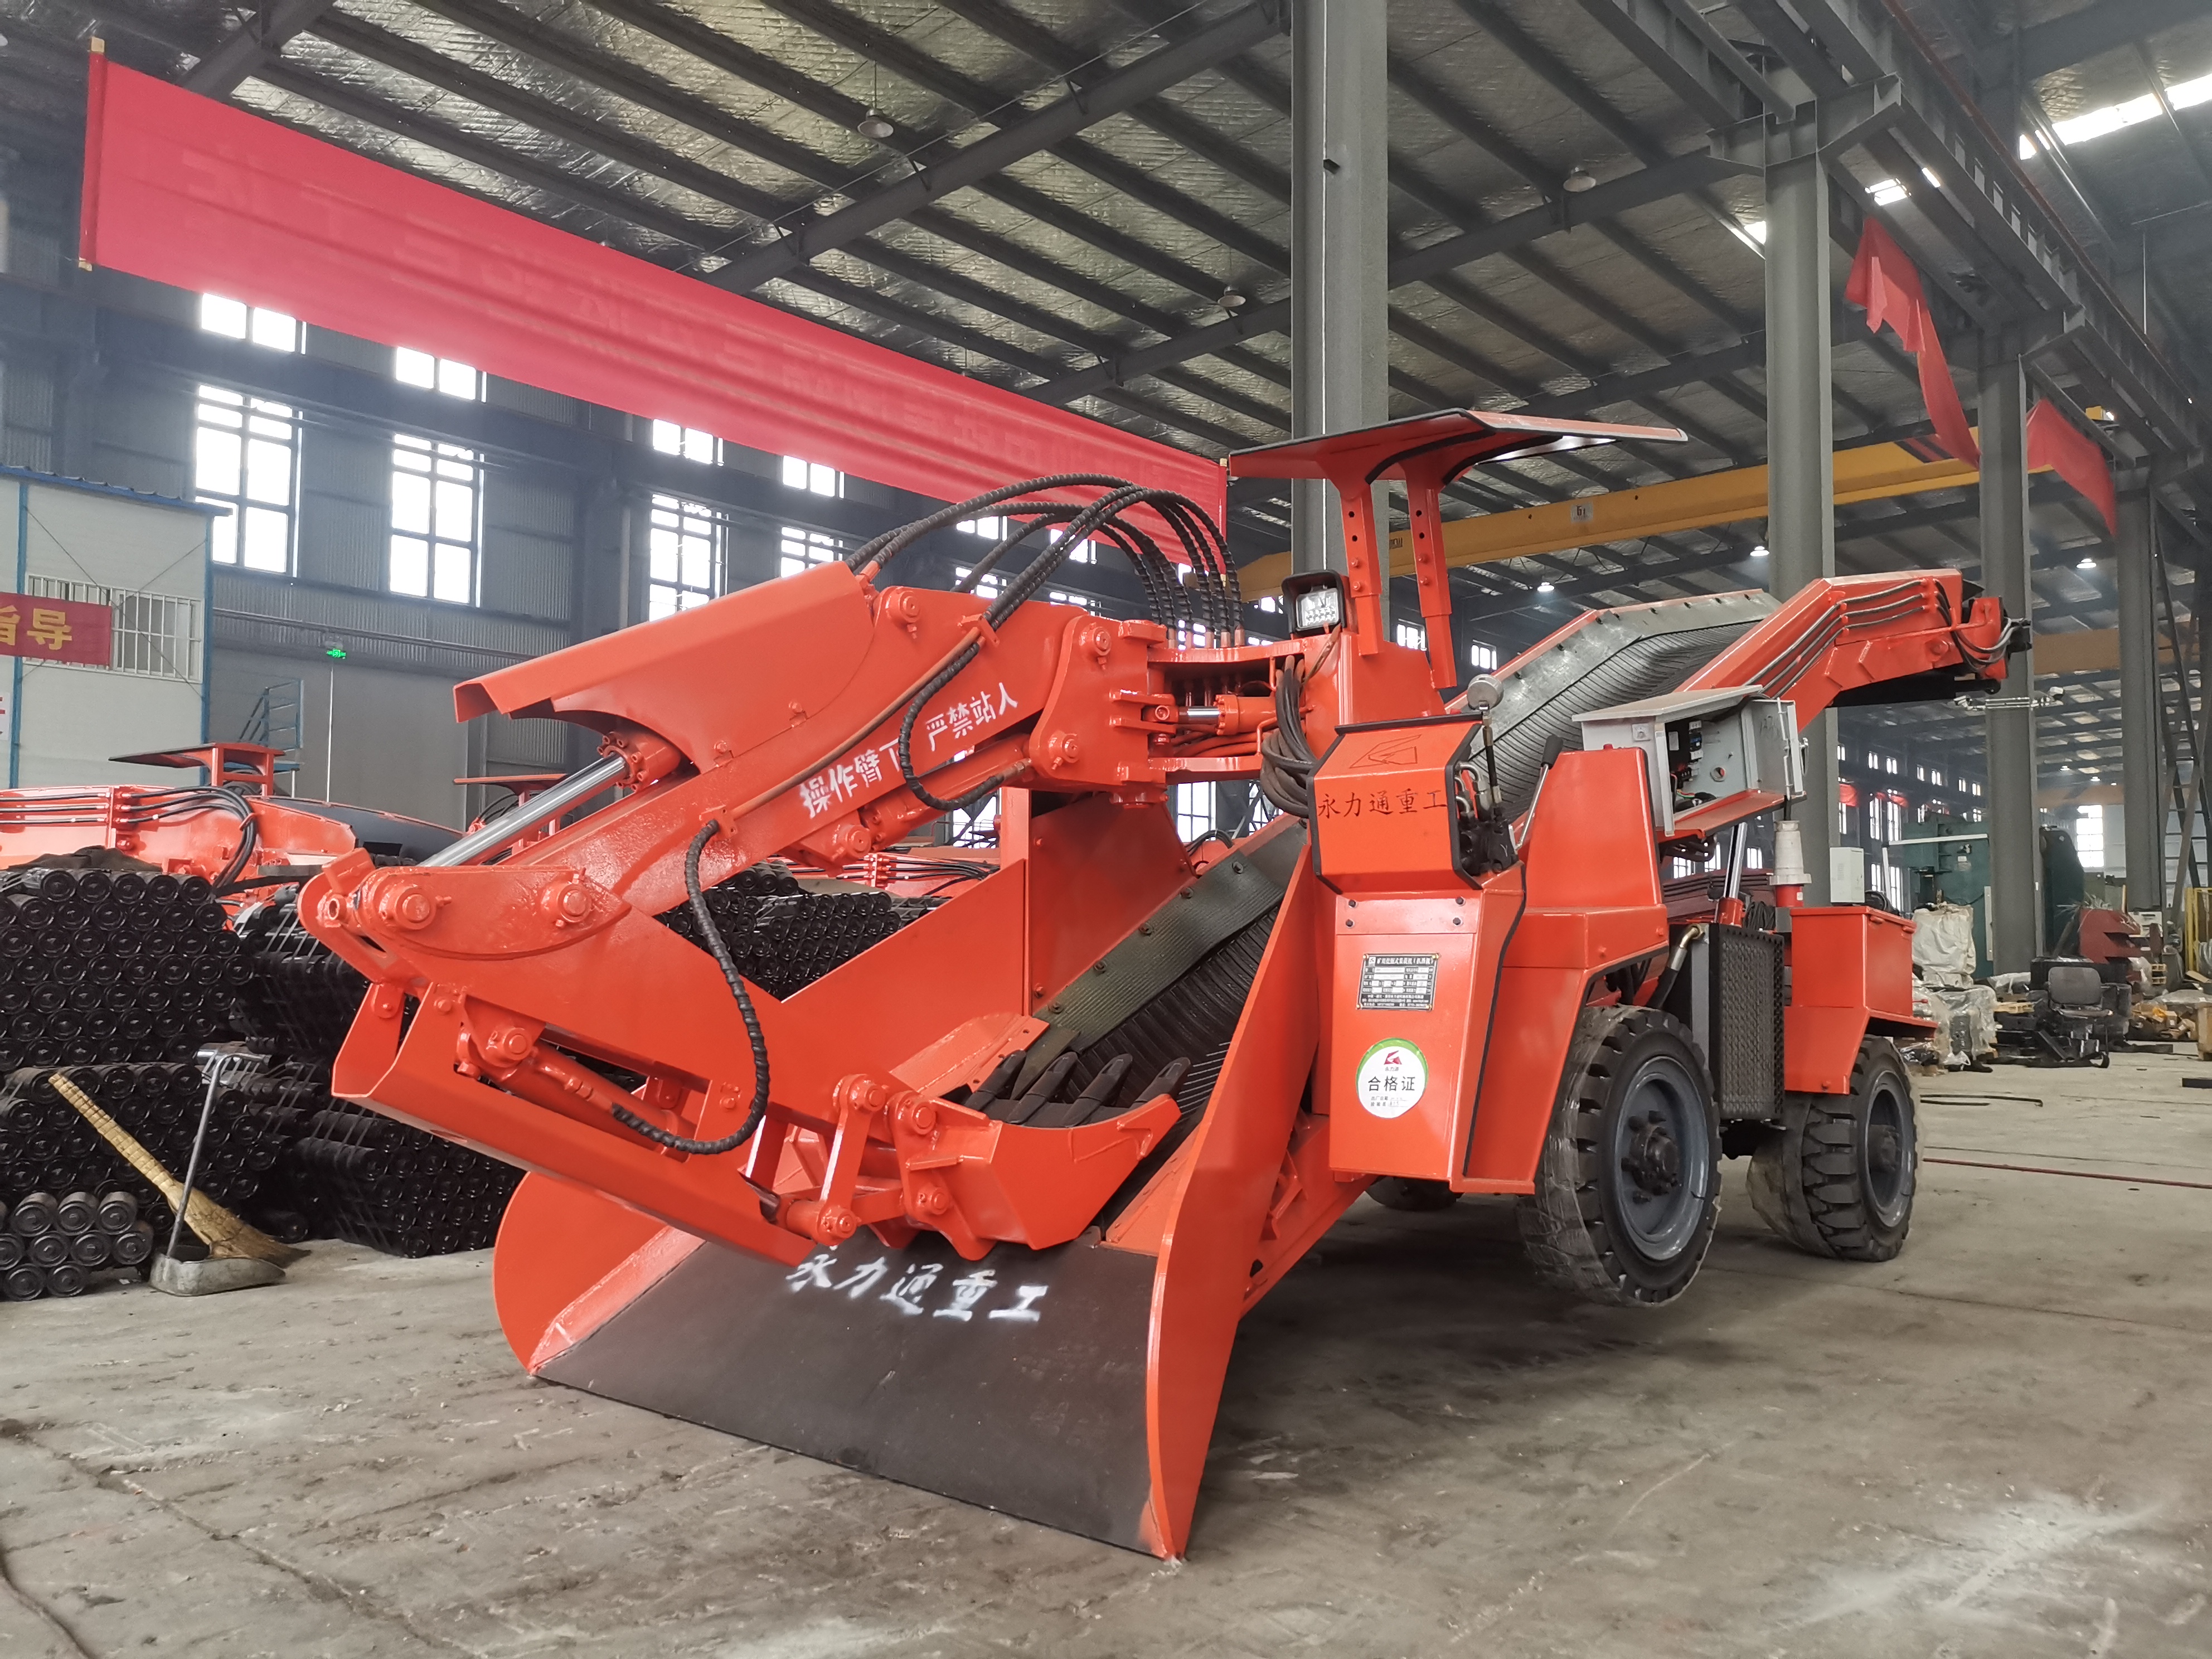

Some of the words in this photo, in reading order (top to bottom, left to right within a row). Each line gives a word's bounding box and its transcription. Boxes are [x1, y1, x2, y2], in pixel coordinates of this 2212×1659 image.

[799, 738, 900, 819] 操作臂下
[925, 682, 1018, 752] 严禁站人
[1318, 788, 1448, 819] 永力通重工
[1368, 1075, 1415, 1092] 合格证
[785, 1246, 1049, 1322] 永力通重工
